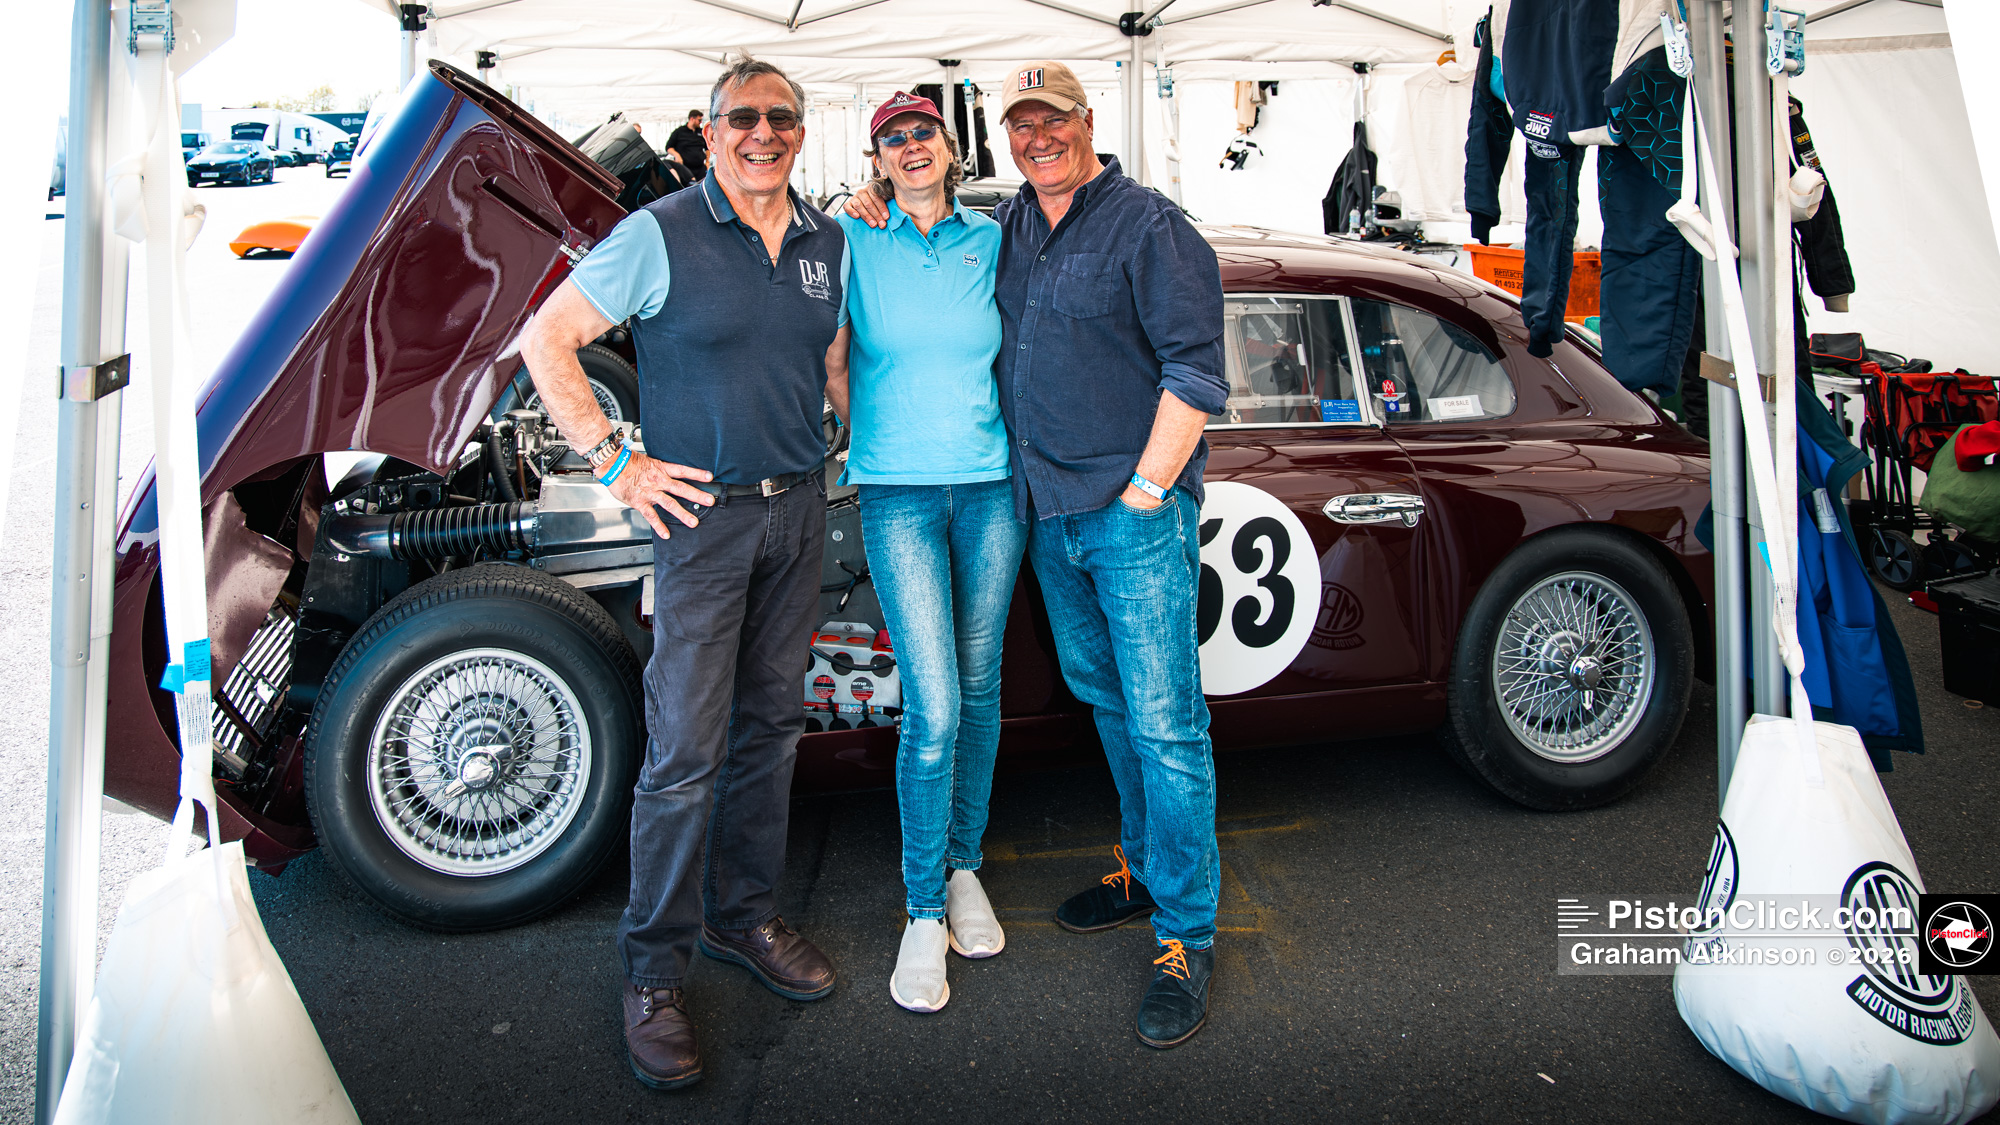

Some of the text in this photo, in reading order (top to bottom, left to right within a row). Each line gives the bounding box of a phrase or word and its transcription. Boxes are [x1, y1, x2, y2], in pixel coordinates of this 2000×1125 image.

[1525, 121, 1550, 136] OMP
[799, 259, 830, 287] DJR
[1444, 399, 1470, 408] FOR SALE
[1854, 981, 1974, 1042] MOTOR RACING LEGENDS
